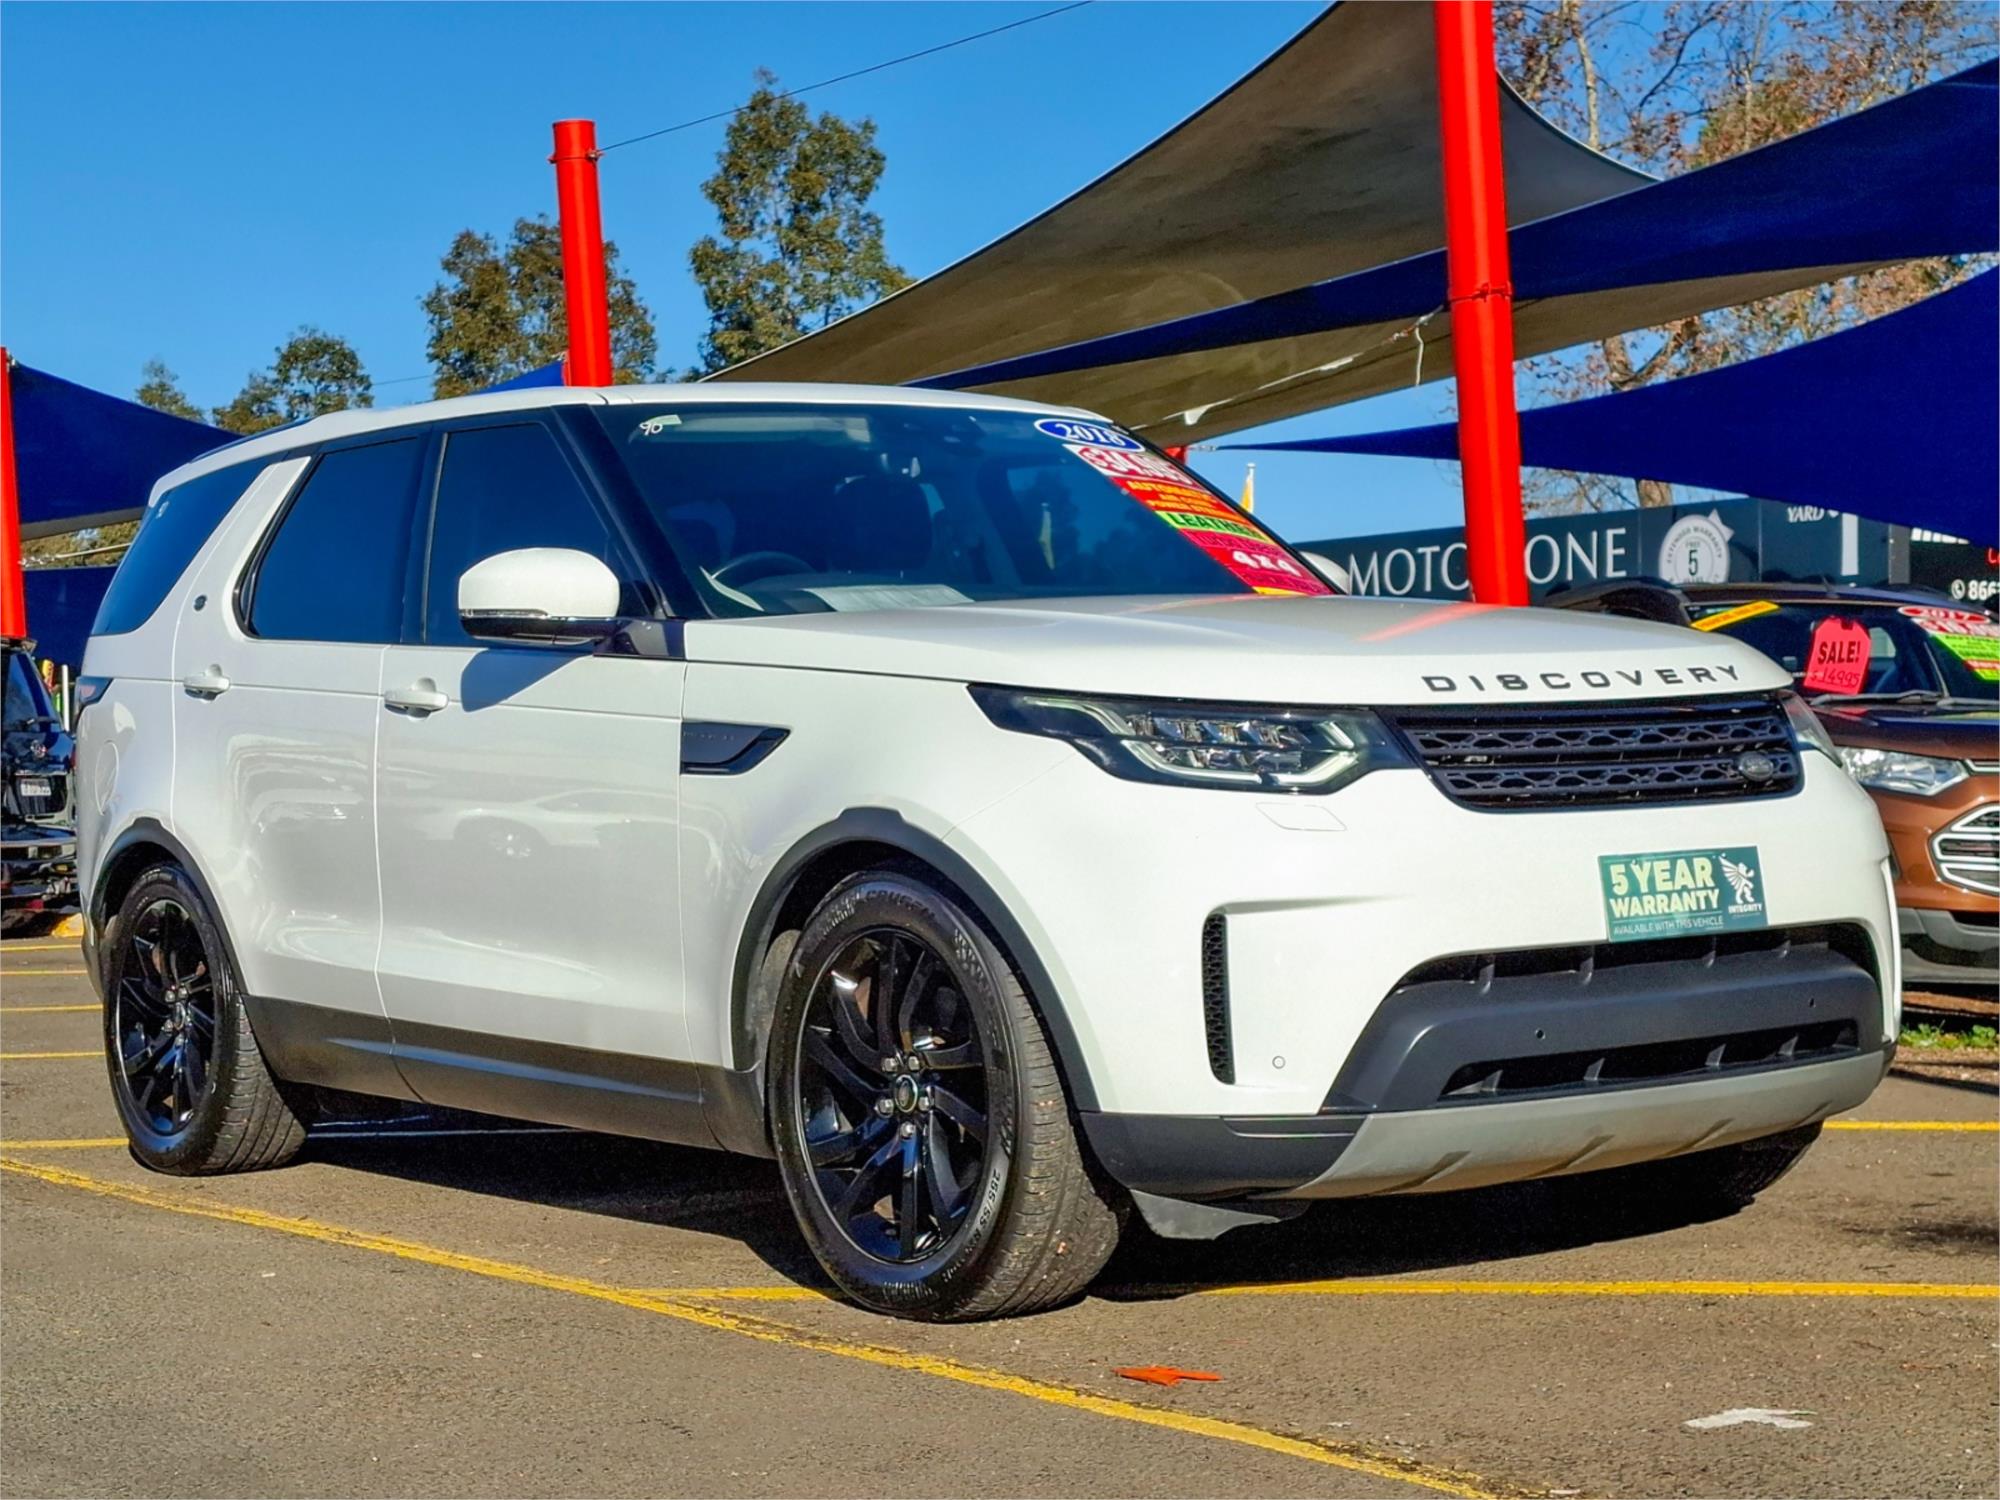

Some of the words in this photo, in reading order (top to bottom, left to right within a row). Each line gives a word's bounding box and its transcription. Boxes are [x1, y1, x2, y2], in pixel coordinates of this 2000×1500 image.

[1055, 423, 1127, 446] 2018
[1787, 505, 1825, 523] YARD
[1350, 543, 1475, 597] MOTO
[1524, 528, 1627, 584] ONE
[1688, 549, 1699, 576] 5
[1968, 579, 2000, 601] 866
[1817, 641, 1861, 665] SALE!
[1421, 665, 1740, 692] DISCOVERY
[1610, 864, 1629, 896] 5
[1632, 857, 1716, 893] YEAR
[1610, 889, 1720, 919] WARRANTY
[1728, 903, 1763, 914] INTEGRITY
[1614, 923, 1654, 935] AVAILABLE
[1655, 922, 1675, 932] WITH
[1675, 919, 1692, 929] THIS
[1693, 915, 1724, 928] VEHICLE
